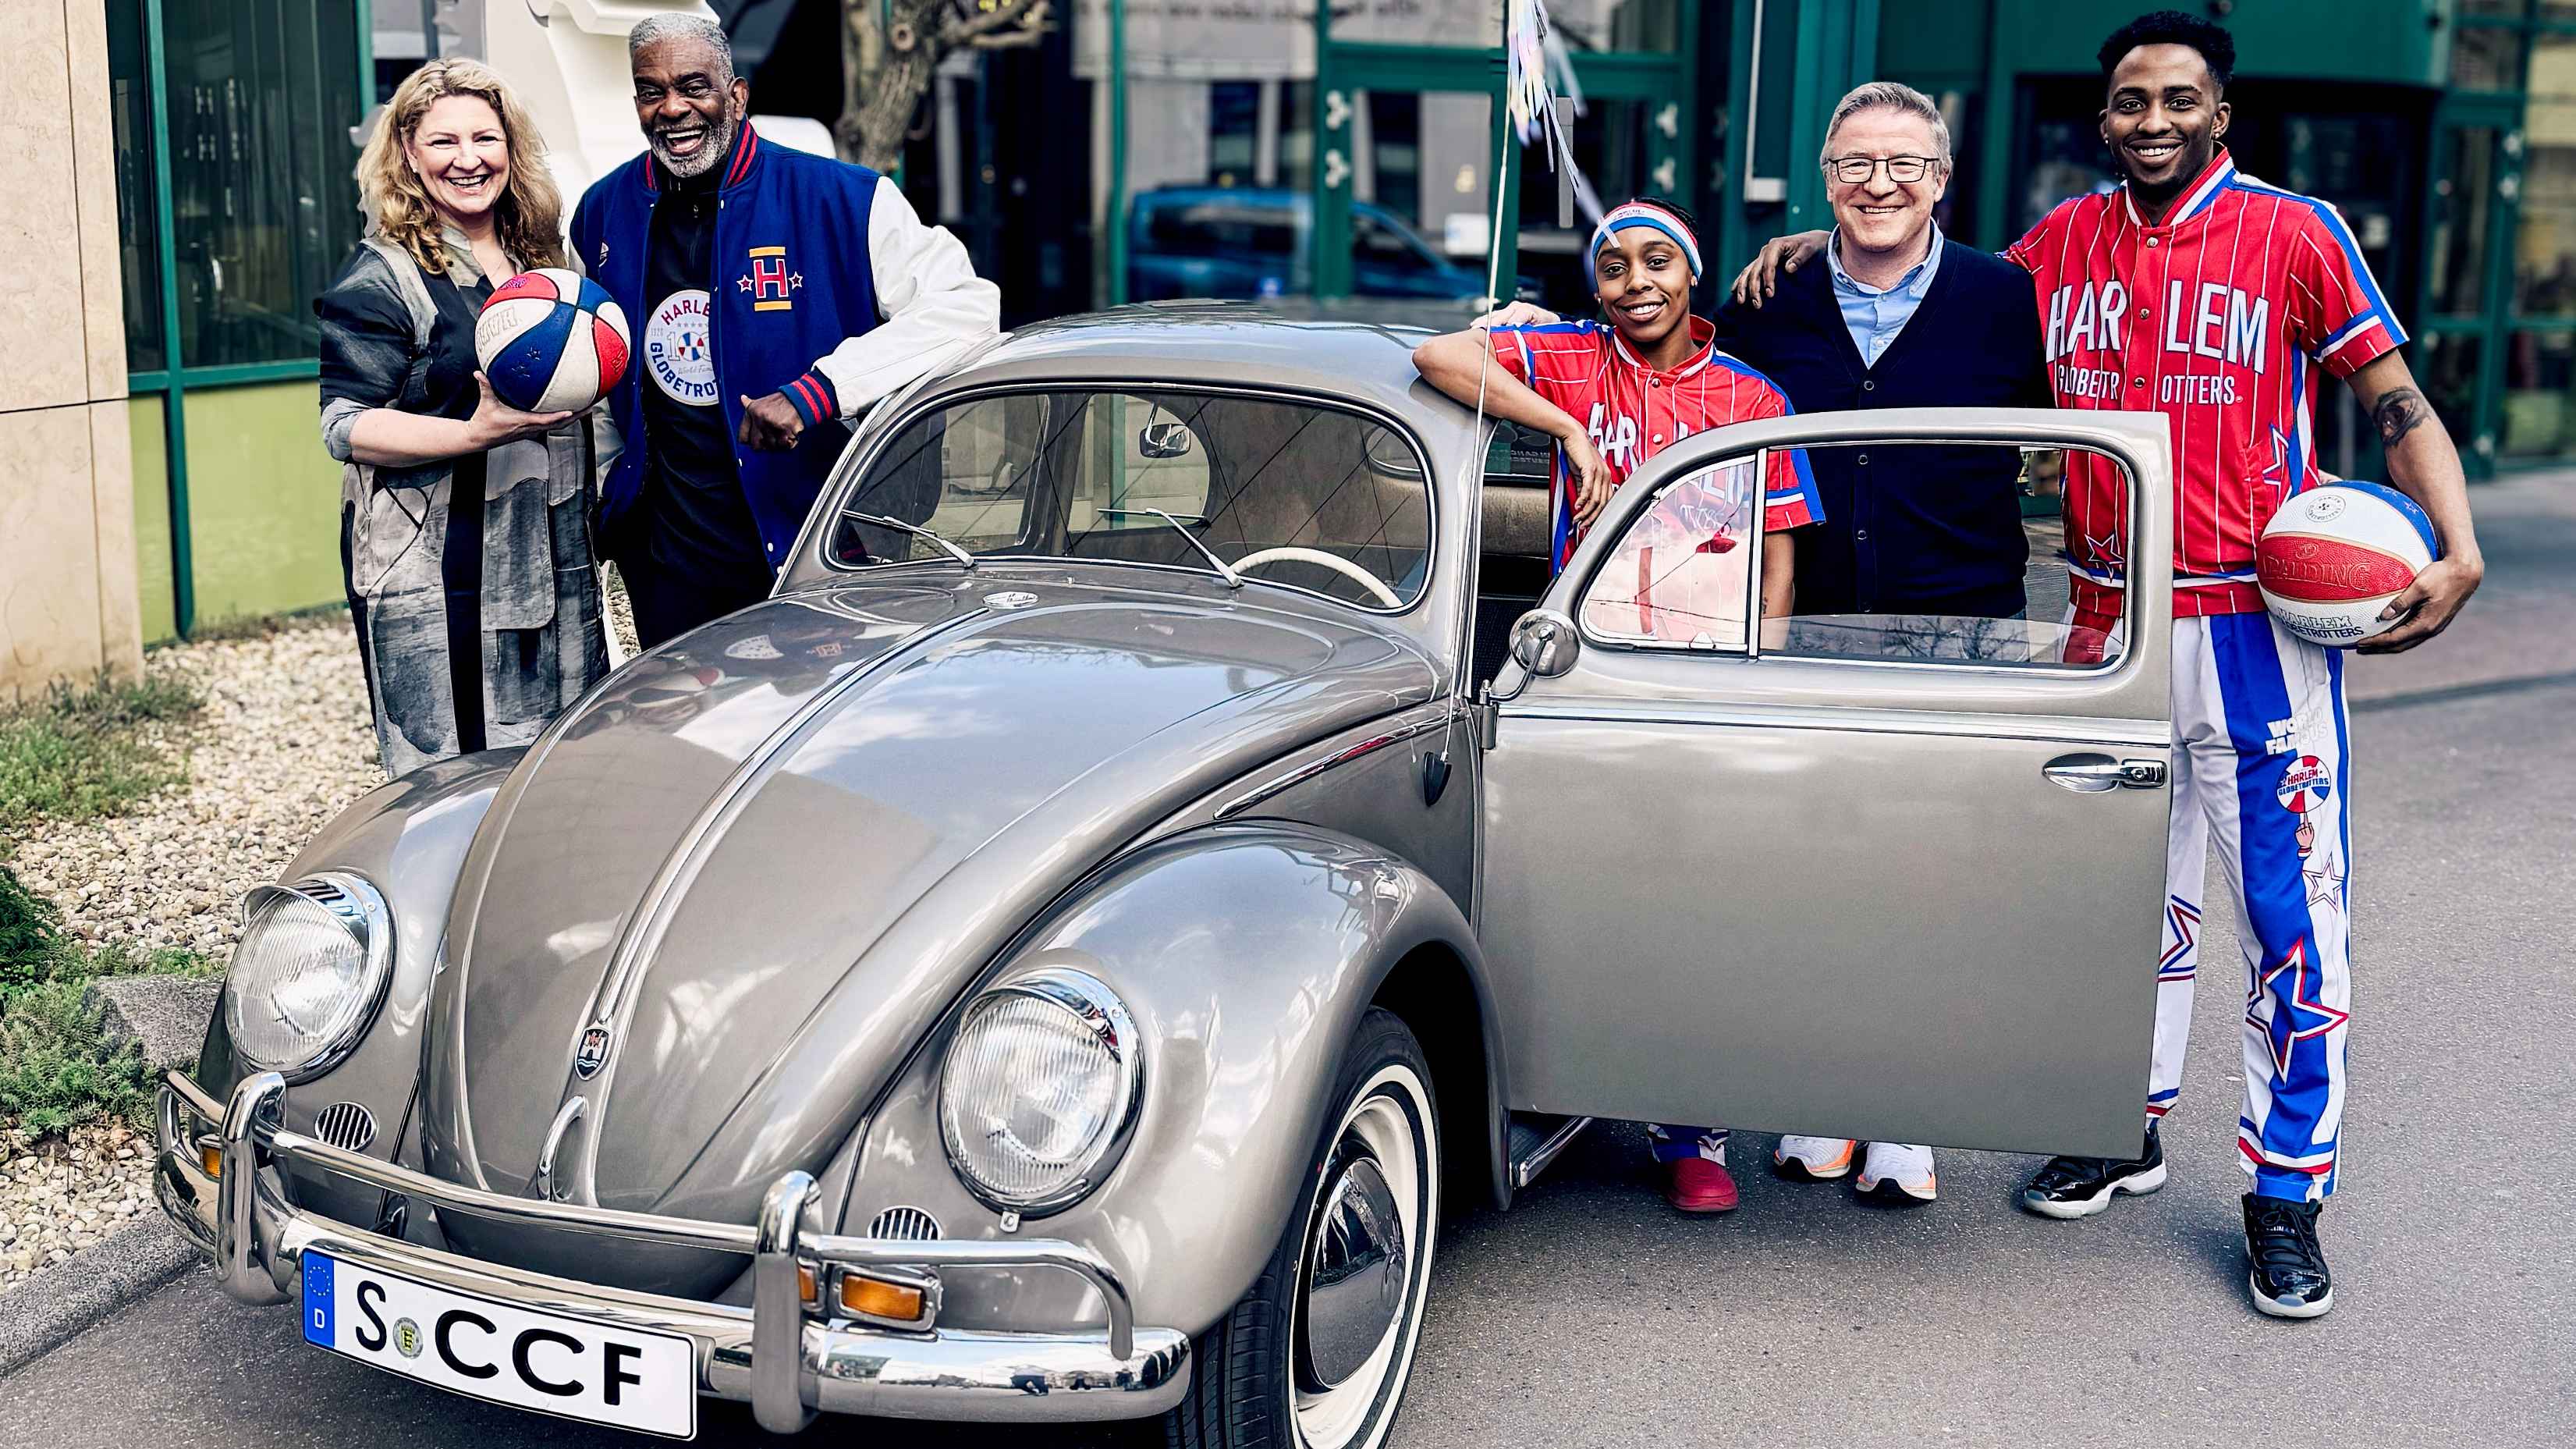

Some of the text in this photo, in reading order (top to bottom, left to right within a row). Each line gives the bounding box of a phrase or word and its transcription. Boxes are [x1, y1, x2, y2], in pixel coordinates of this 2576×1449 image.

[754, 258, 789, 299] H
[662, 299, 710, 325] HARLE
[650, 342, 719, 397] GLOBETRO
[2278, 607, 2353, 629] HARLEM
[2287, 769, 2319, 785] HARLEM
[314, 1307, 325, 1329] D
[356, 1280, 642, 1406] S CCF
